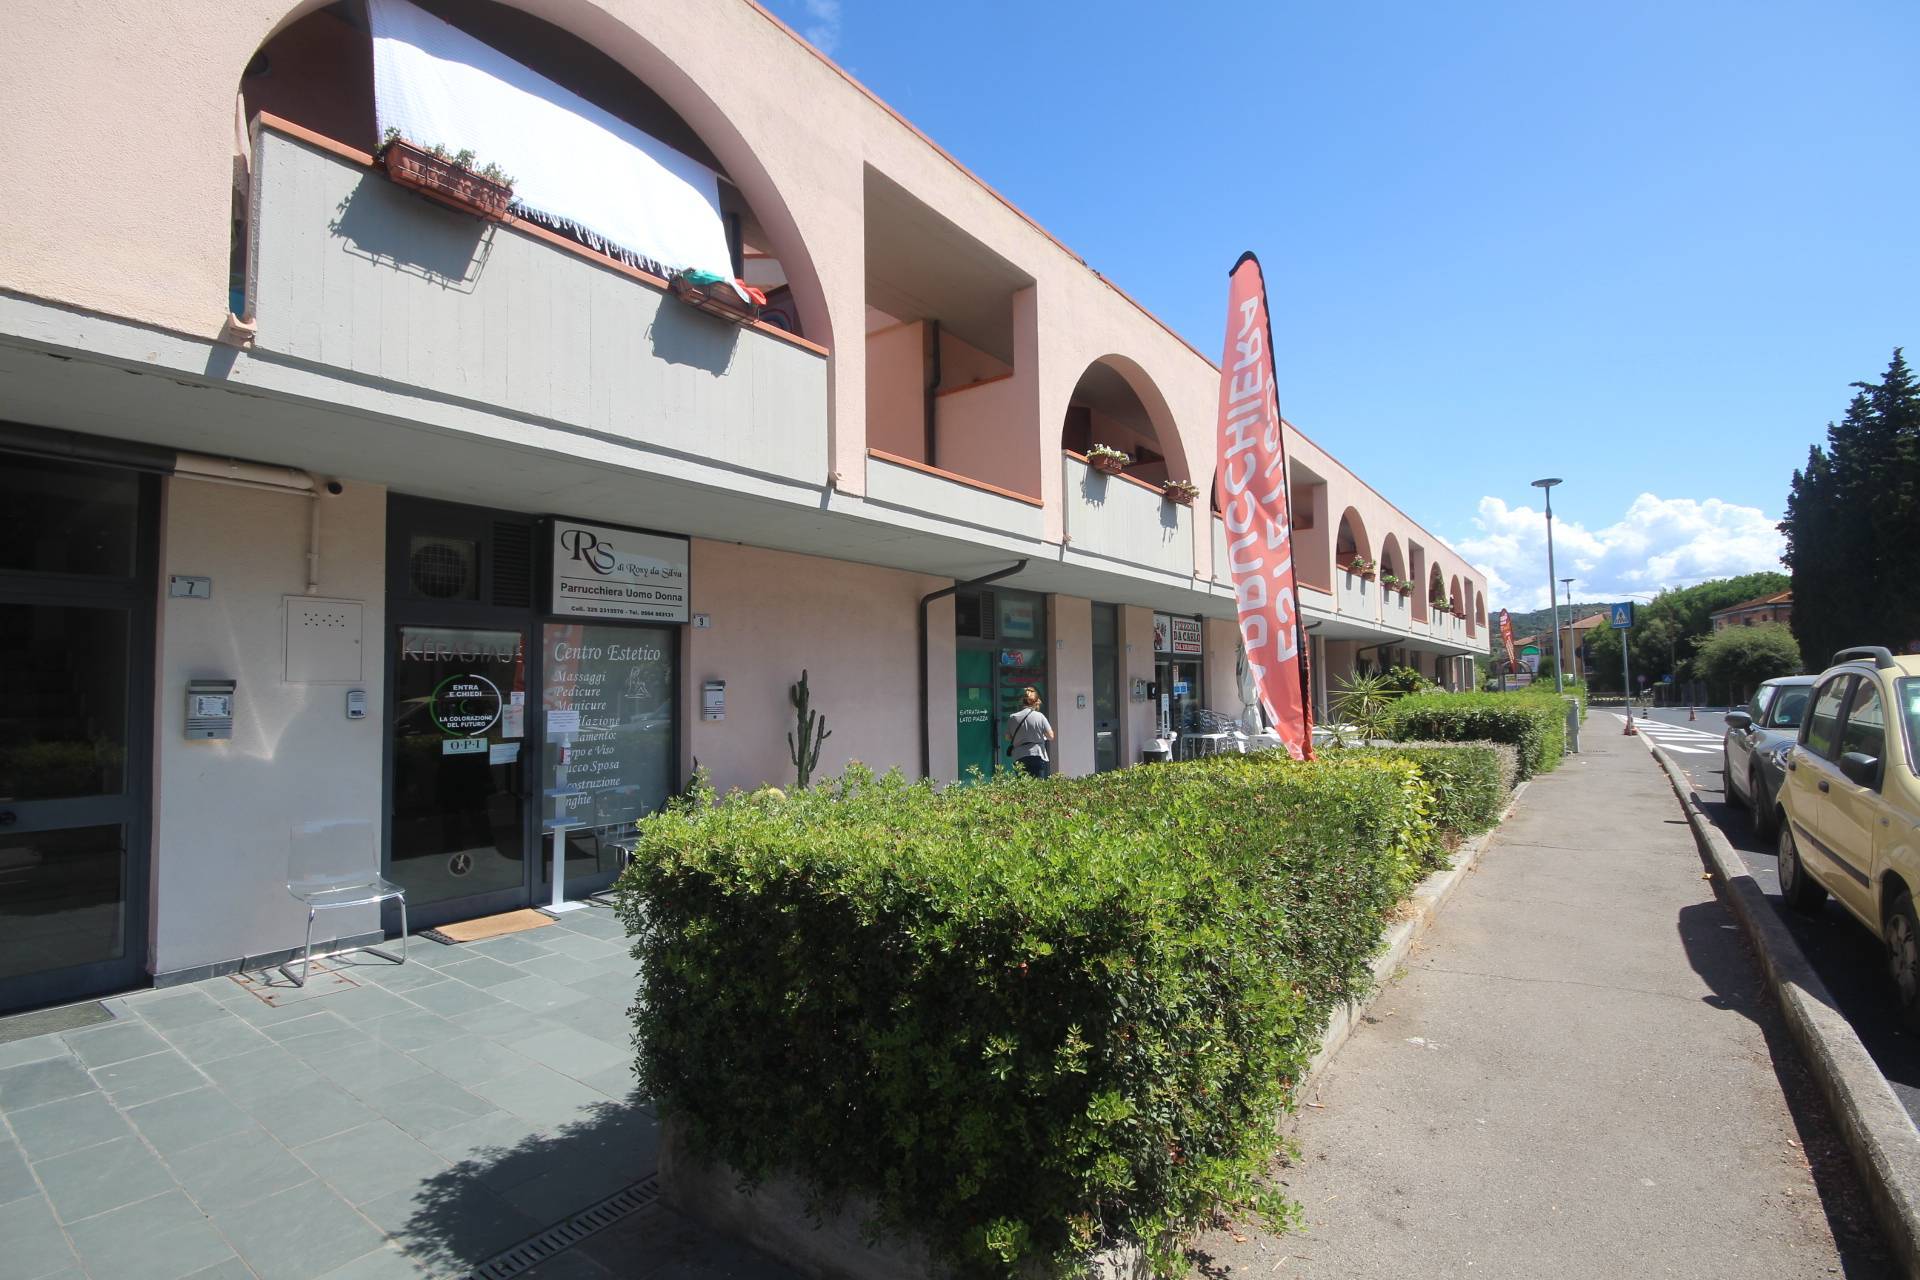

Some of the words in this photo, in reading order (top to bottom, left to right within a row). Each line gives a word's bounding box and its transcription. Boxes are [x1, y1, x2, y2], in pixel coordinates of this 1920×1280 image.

[560, 529, 615, 575] RS
[617, 563, 624, 571] di
[650, 566, 660, 574] da
[662, 567, 682, 578] Silva
[186, 581, 195, 595] 7
[560, 582, 623, 596] Parrucchiera
[626, 588, 653, 599] Uomo
[655, 591, 682, 601] Donna
[699, 617, 704, 626] 9
[554, 643, 602, 661] Centro
[608, 644, 661, 661] Estetico
[553, 671, 607, 686] Massaggi
[555, 685, 601, 697] Pedicure
[558, 699, 607, 711] Manicure
[595, 744, 615, 755] Viso
[590, 760, 620, 774] Sposa
